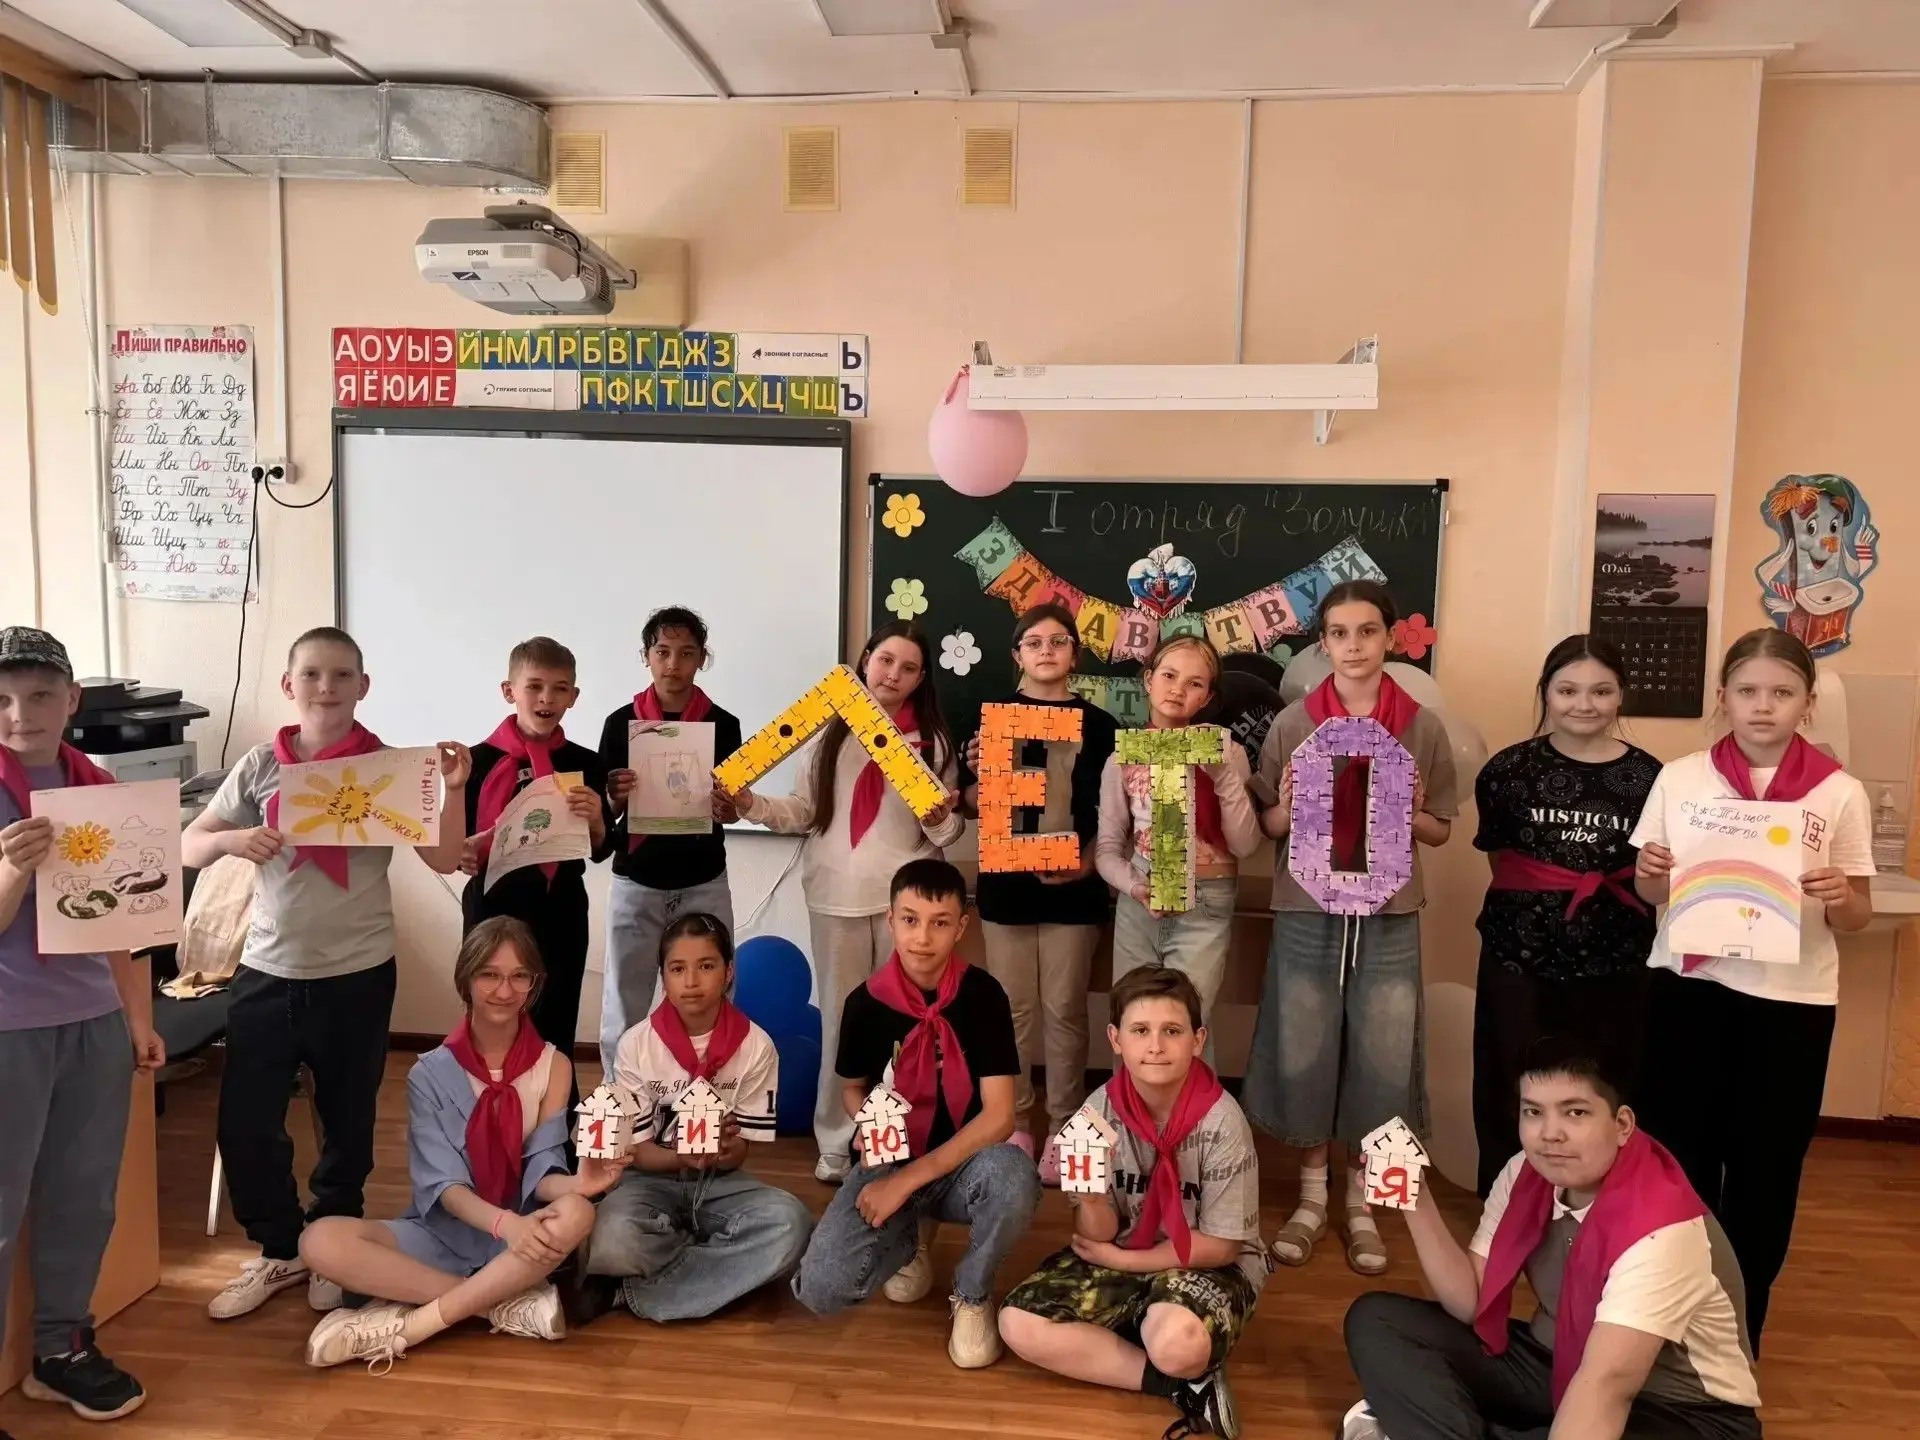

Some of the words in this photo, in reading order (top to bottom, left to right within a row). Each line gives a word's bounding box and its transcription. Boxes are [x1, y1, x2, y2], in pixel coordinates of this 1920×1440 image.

[164, 336, 248, 354] ПРАВИЛЬНО
[1091, 500, 1247, 558] отряд
[1530, 808, 1634, 836] MISTICAL
[1560, 827, 1598, 843] vibe
[587, 1119, 606, 1150] 1
[687, 1118, 706, 1144] И
[870, 1124, 901, 1156] Ю
[1067, 1154, 1091, 1181] Н
[1373, 1166, 1411, 1204] Я
